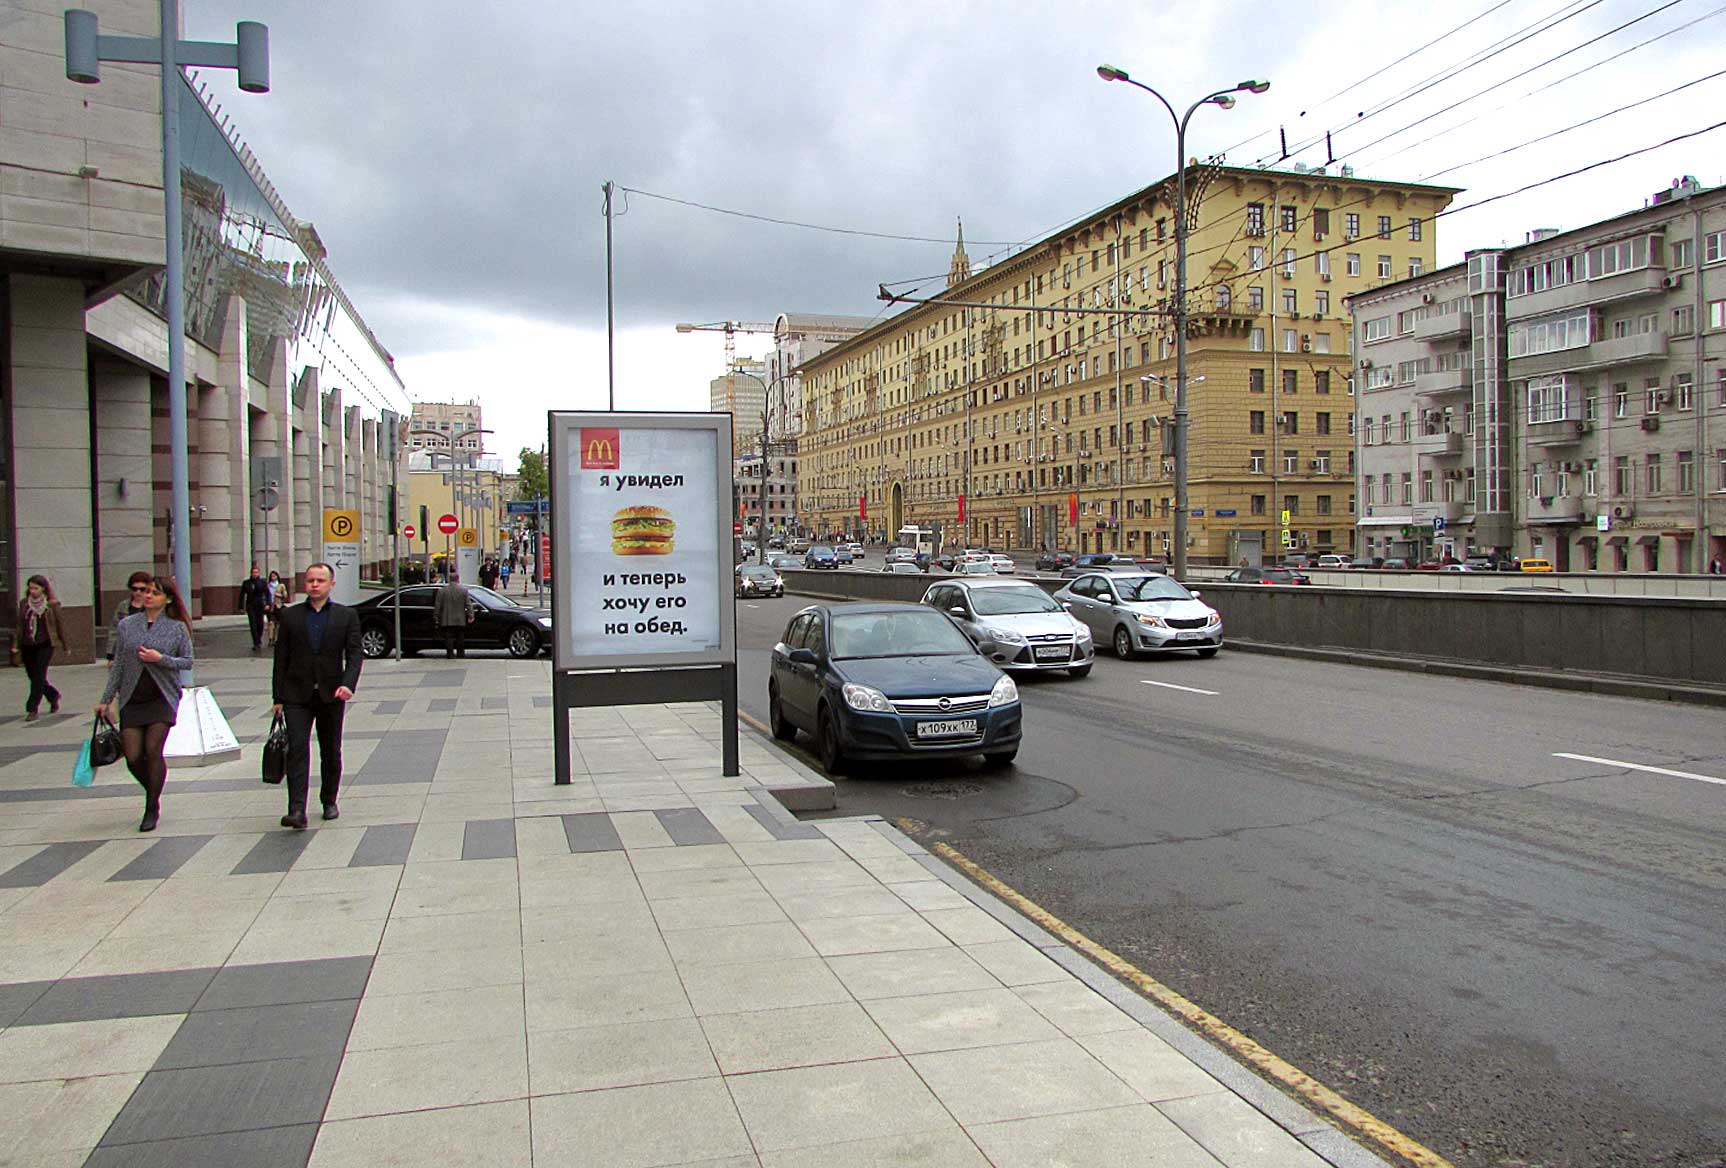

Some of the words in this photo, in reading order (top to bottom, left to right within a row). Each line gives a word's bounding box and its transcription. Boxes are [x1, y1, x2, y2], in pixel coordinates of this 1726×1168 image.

[599, 475, 610, 487] я
[616, 474, 684, 491] увидел
[603, 574, 615, 586] и
[620, 573, 687, 589] теперь
[602, 597, 650, 613] хочу
[655, 595, 687, 609] его
[604, 622, 628, 634] на
[634, 616, 688, 635] обед.
